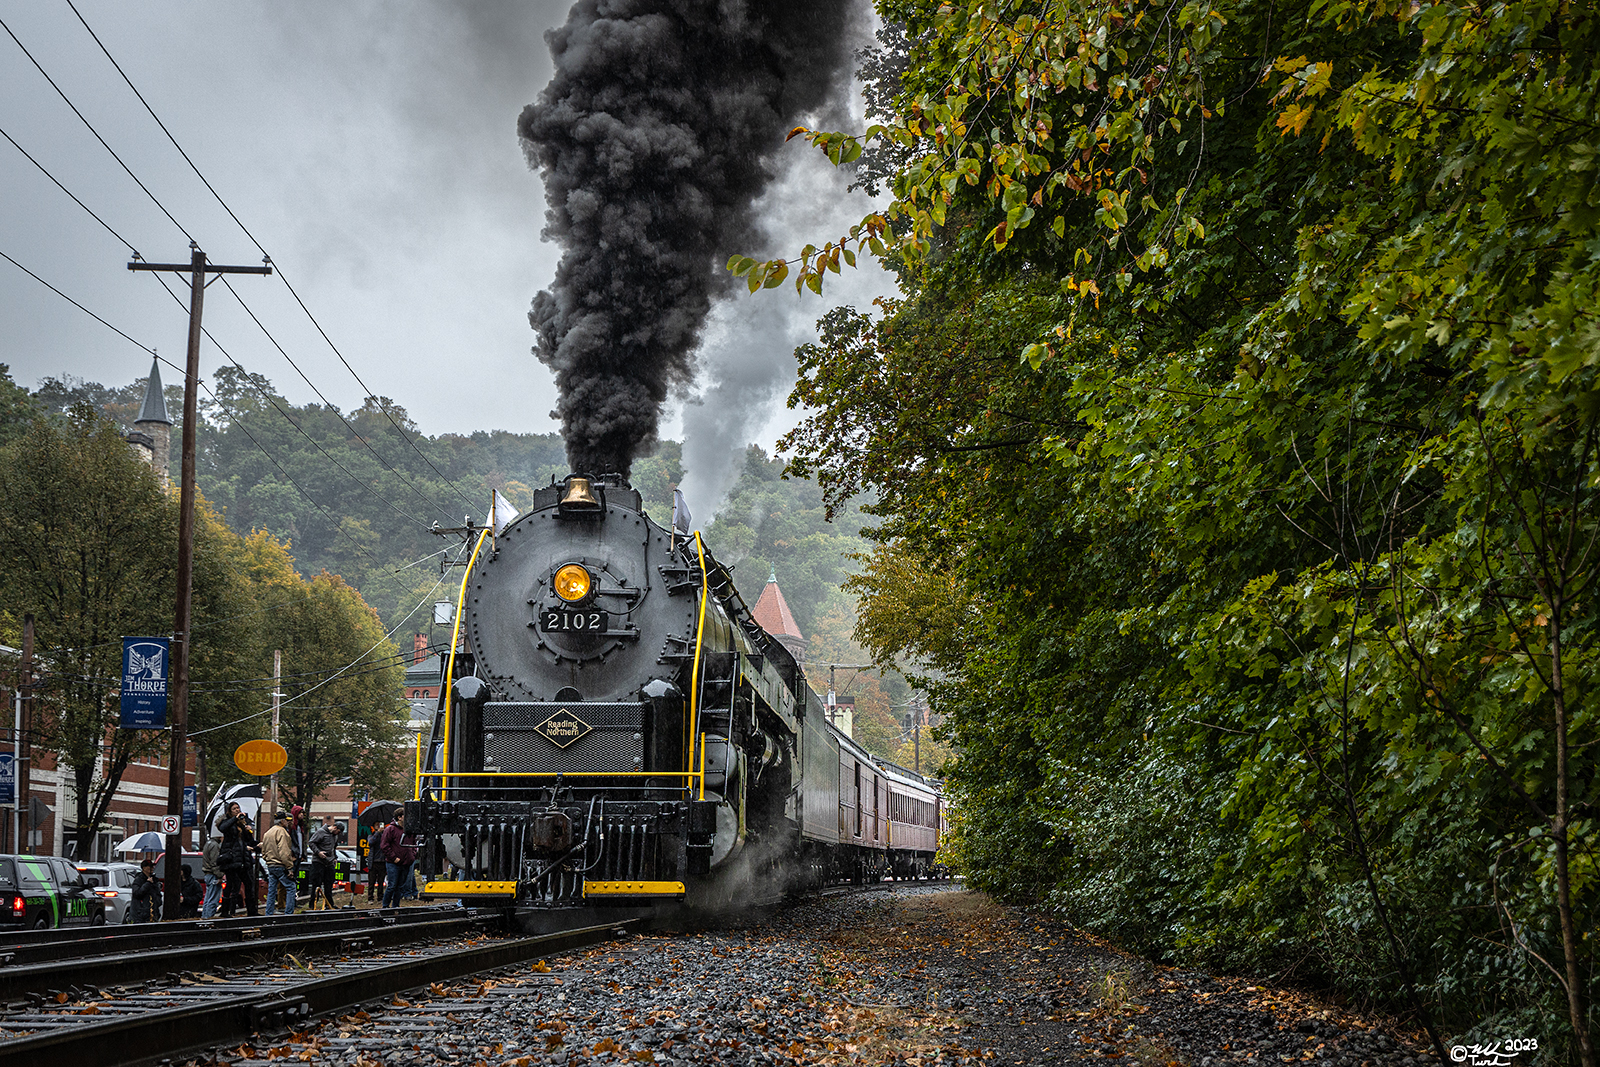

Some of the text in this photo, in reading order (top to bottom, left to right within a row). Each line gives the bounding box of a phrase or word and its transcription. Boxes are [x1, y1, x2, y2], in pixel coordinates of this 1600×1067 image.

[547, 613, 600, 629] 2102
[127, 677, 166, 692] THORPE
[546, 728, 579, 736] Northern
[547, 720, 578, 730] Reading
[238, 750, 283, 764] DERAIL
